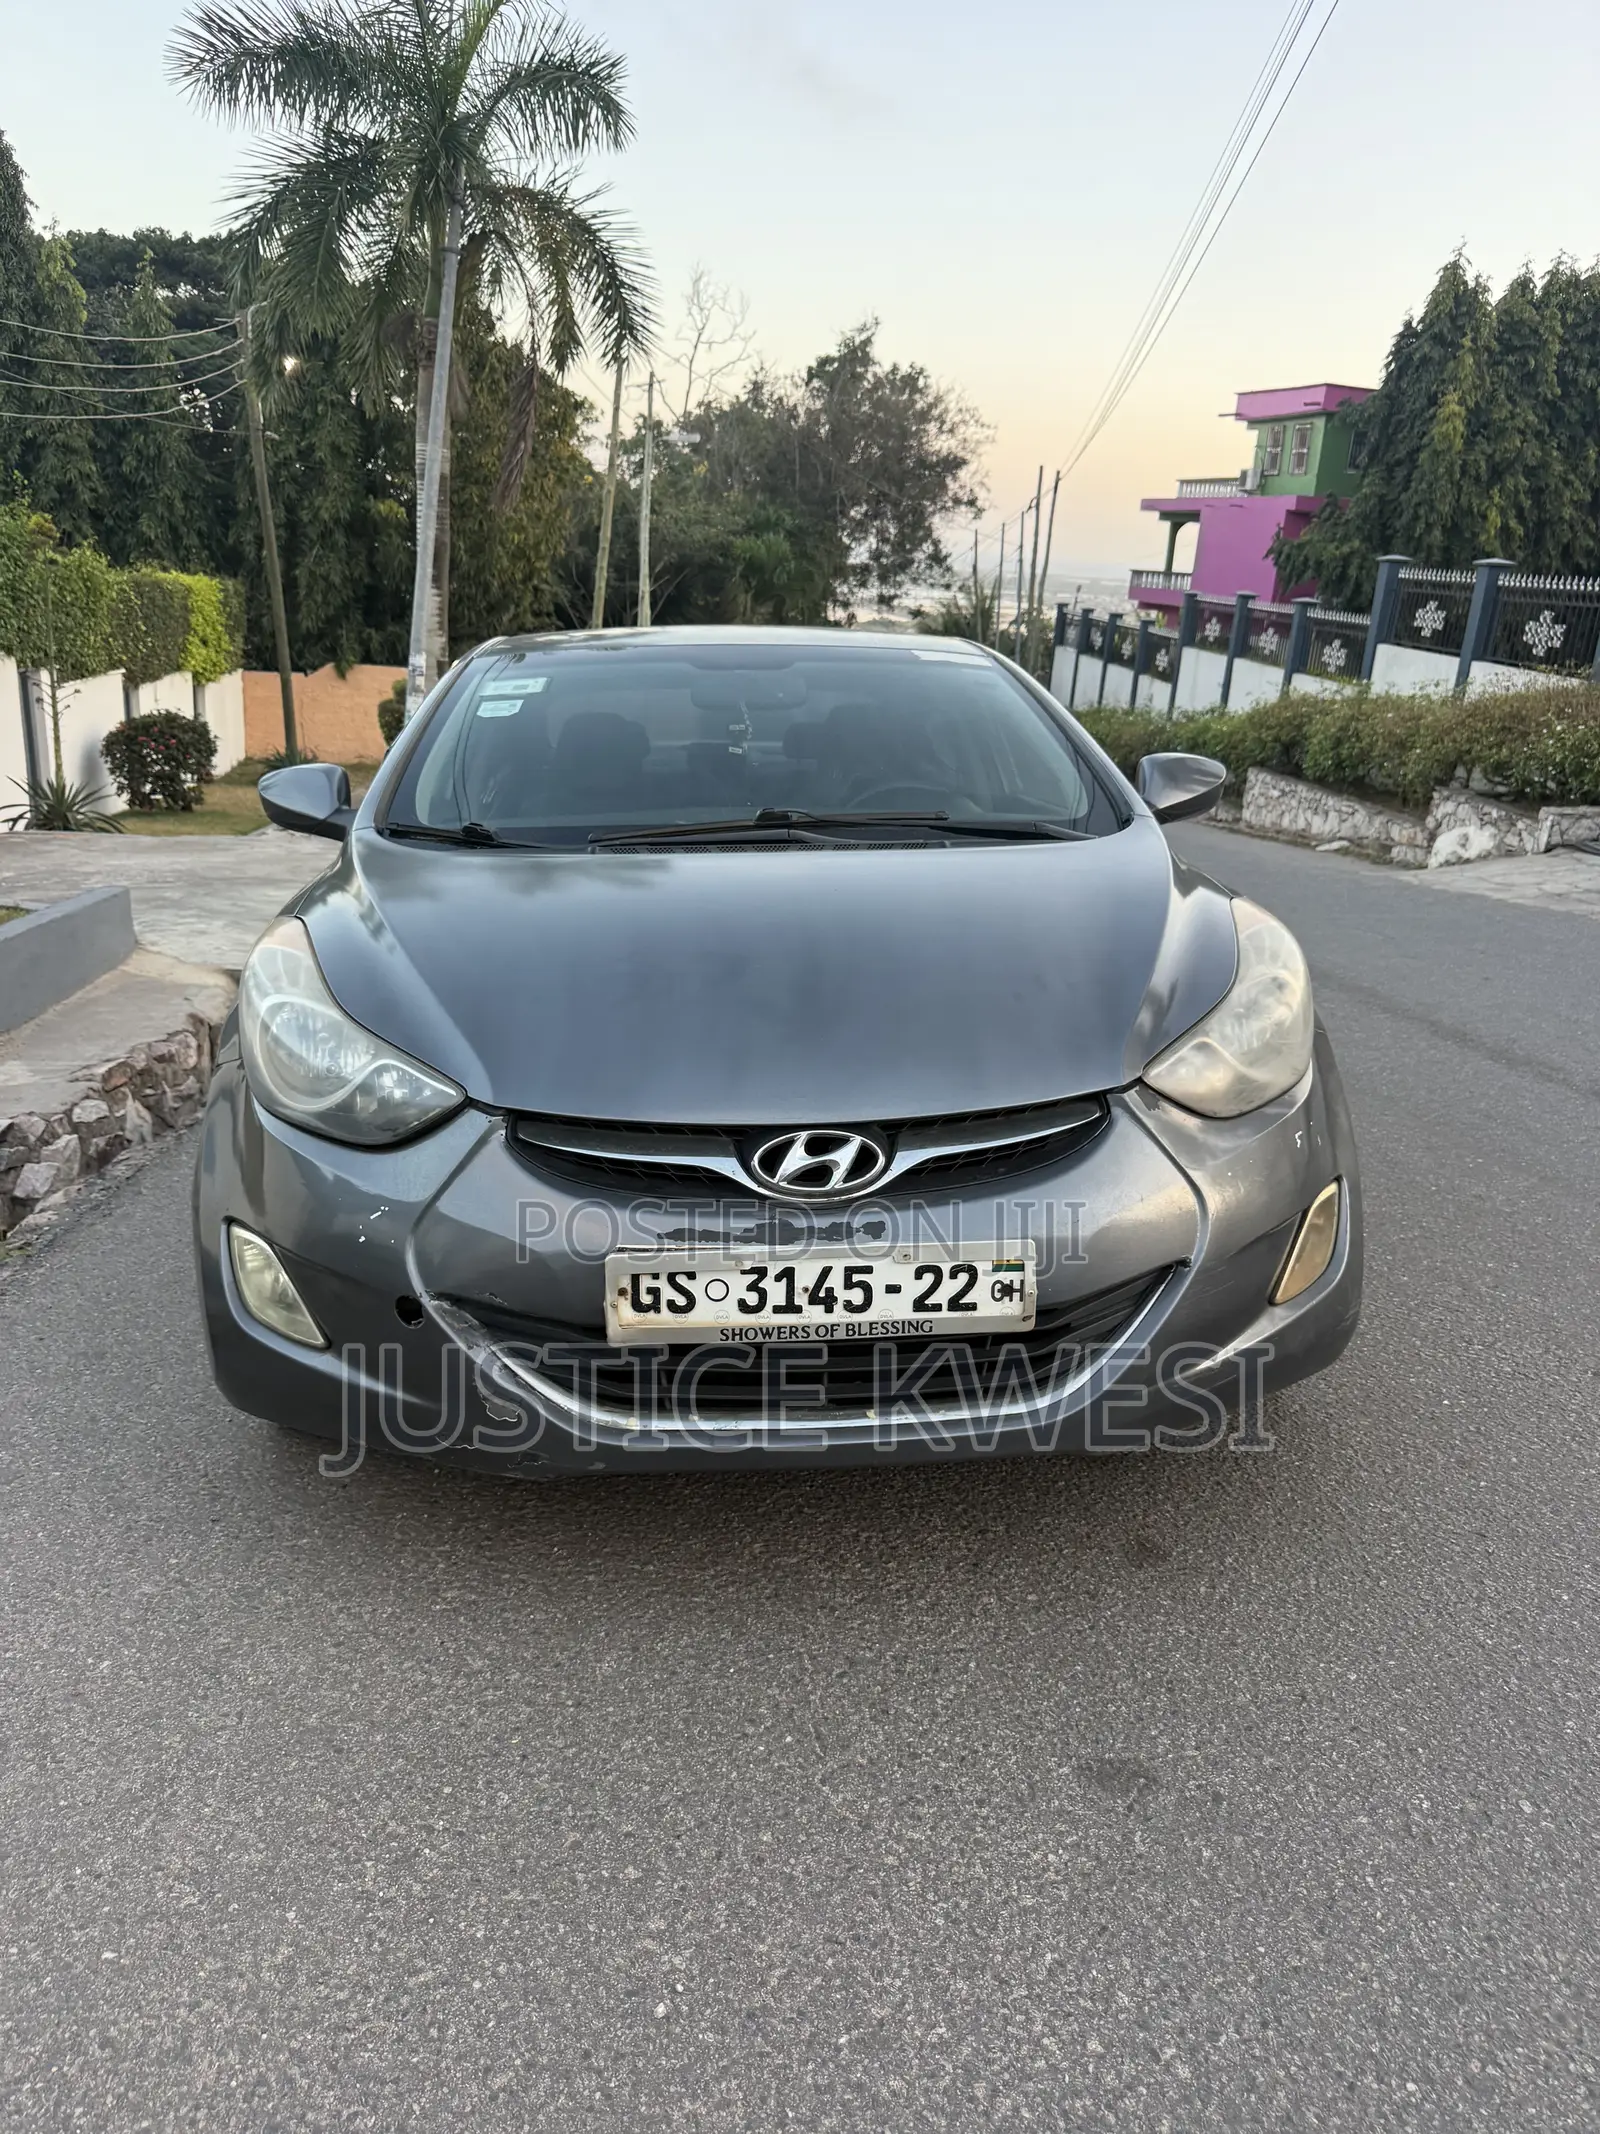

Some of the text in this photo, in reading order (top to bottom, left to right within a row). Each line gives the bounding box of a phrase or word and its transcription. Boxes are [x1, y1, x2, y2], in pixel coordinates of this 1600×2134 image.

[630, 1270, 697, 1315] GS
[719, 1319, 934, 1342] SHOWERS OF BLESSING
